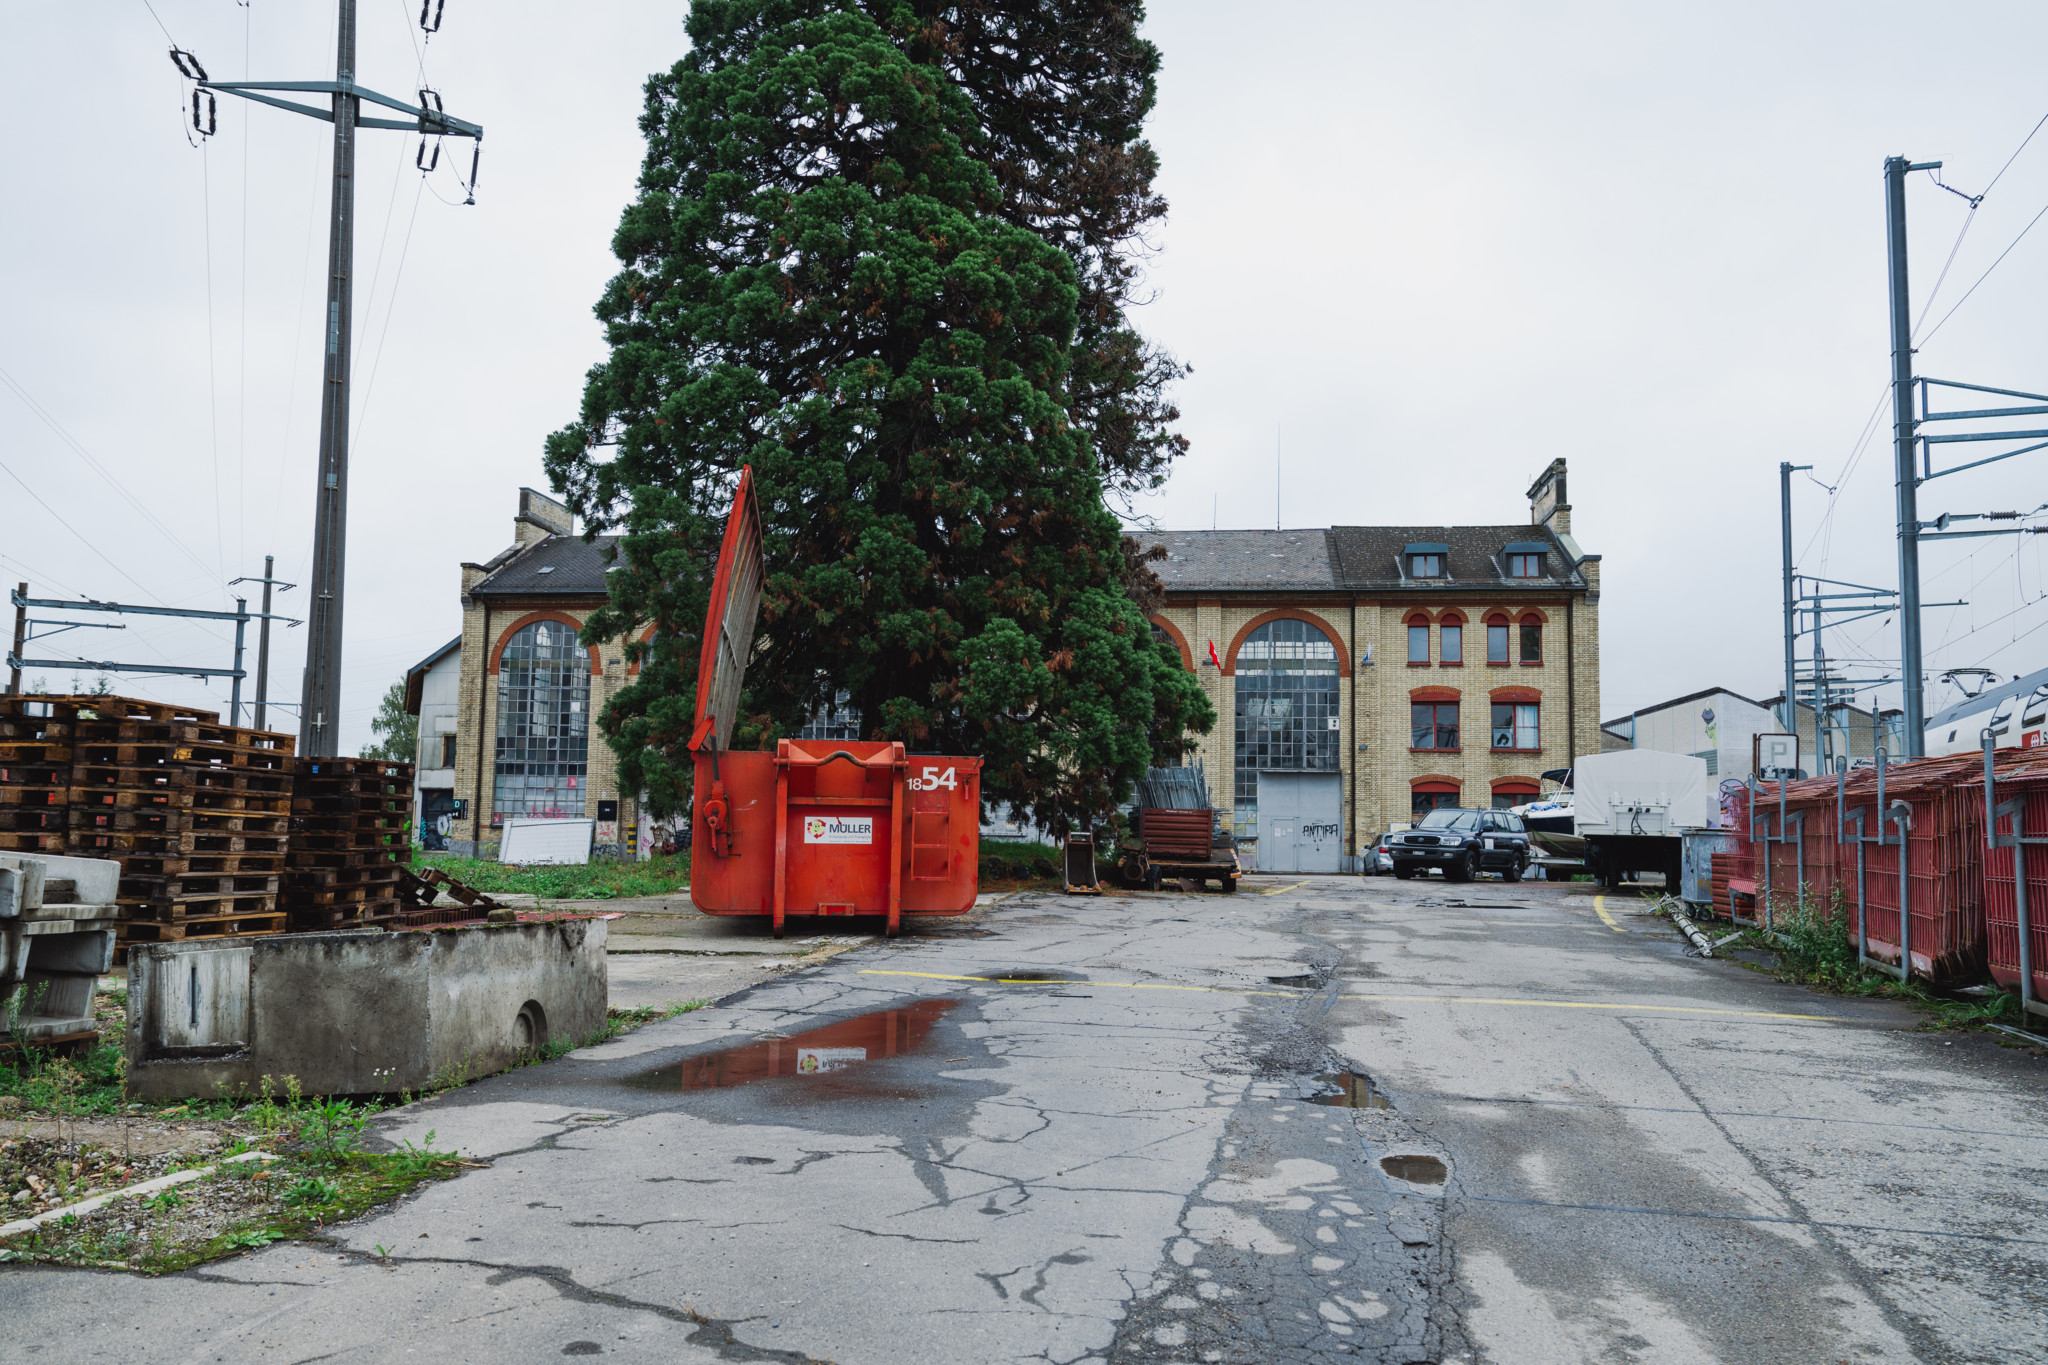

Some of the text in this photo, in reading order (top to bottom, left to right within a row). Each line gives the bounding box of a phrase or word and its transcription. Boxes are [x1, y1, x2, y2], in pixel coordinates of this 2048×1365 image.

[1770, 741, 1787, 764] P
[907, 766, 958, 791] 1854
[454, 800, 460, 808] D
[829, 823, 871, 834] MÜLLER
